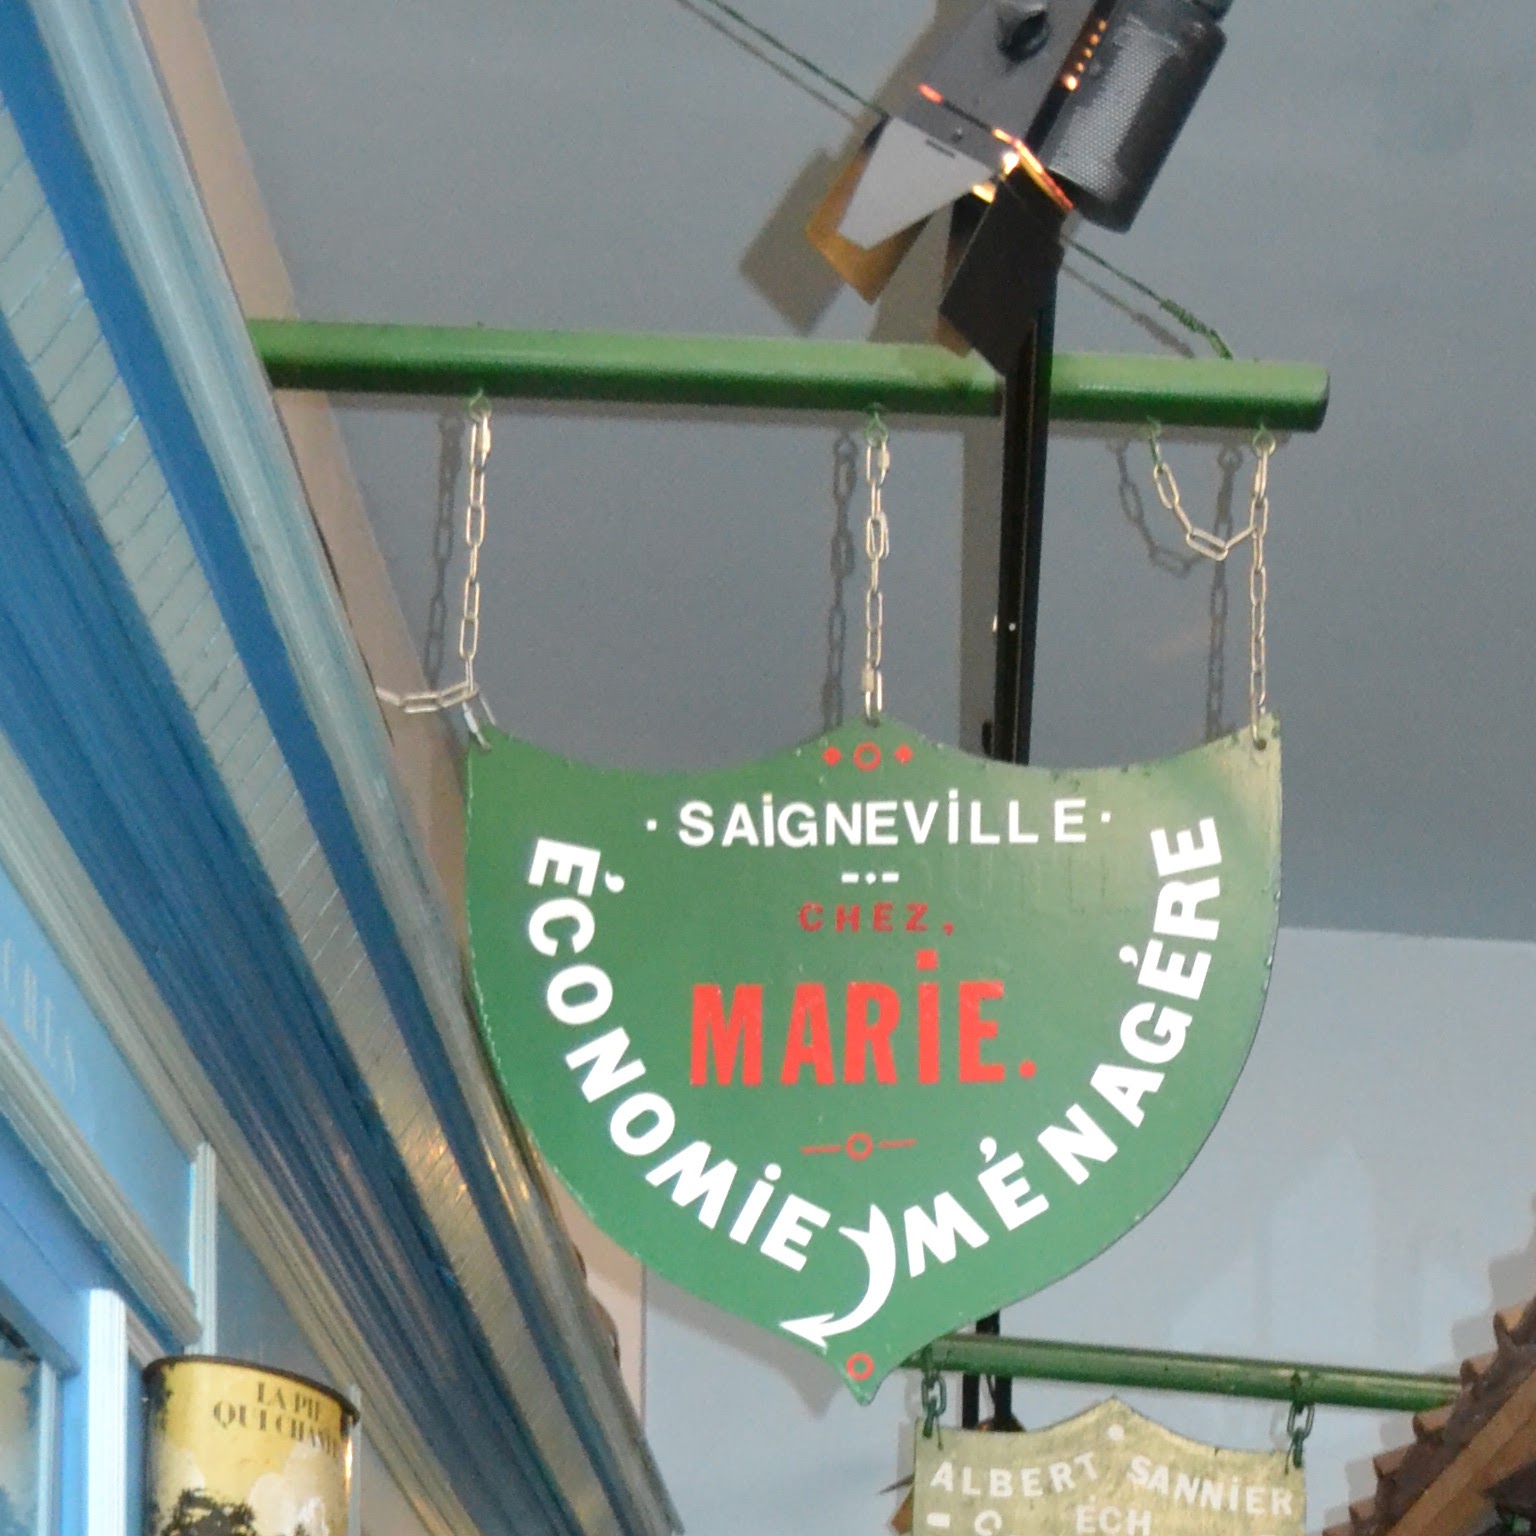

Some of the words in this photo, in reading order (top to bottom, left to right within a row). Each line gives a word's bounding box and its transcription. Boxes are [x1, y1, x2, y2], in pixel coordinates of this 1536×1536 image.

[677, 788, 1089, 848] SAIGNEVILLE
[689, 949, 1037, 1087] MARIE.
[527, 837, 832, 1272] ÉCONOMIE
[930, 1451, 1097, 1498] ALBERT
[1127, 1455, 1293, 1516] SANNIER
[1075, 1495, 1152, 1536] ÉCH
